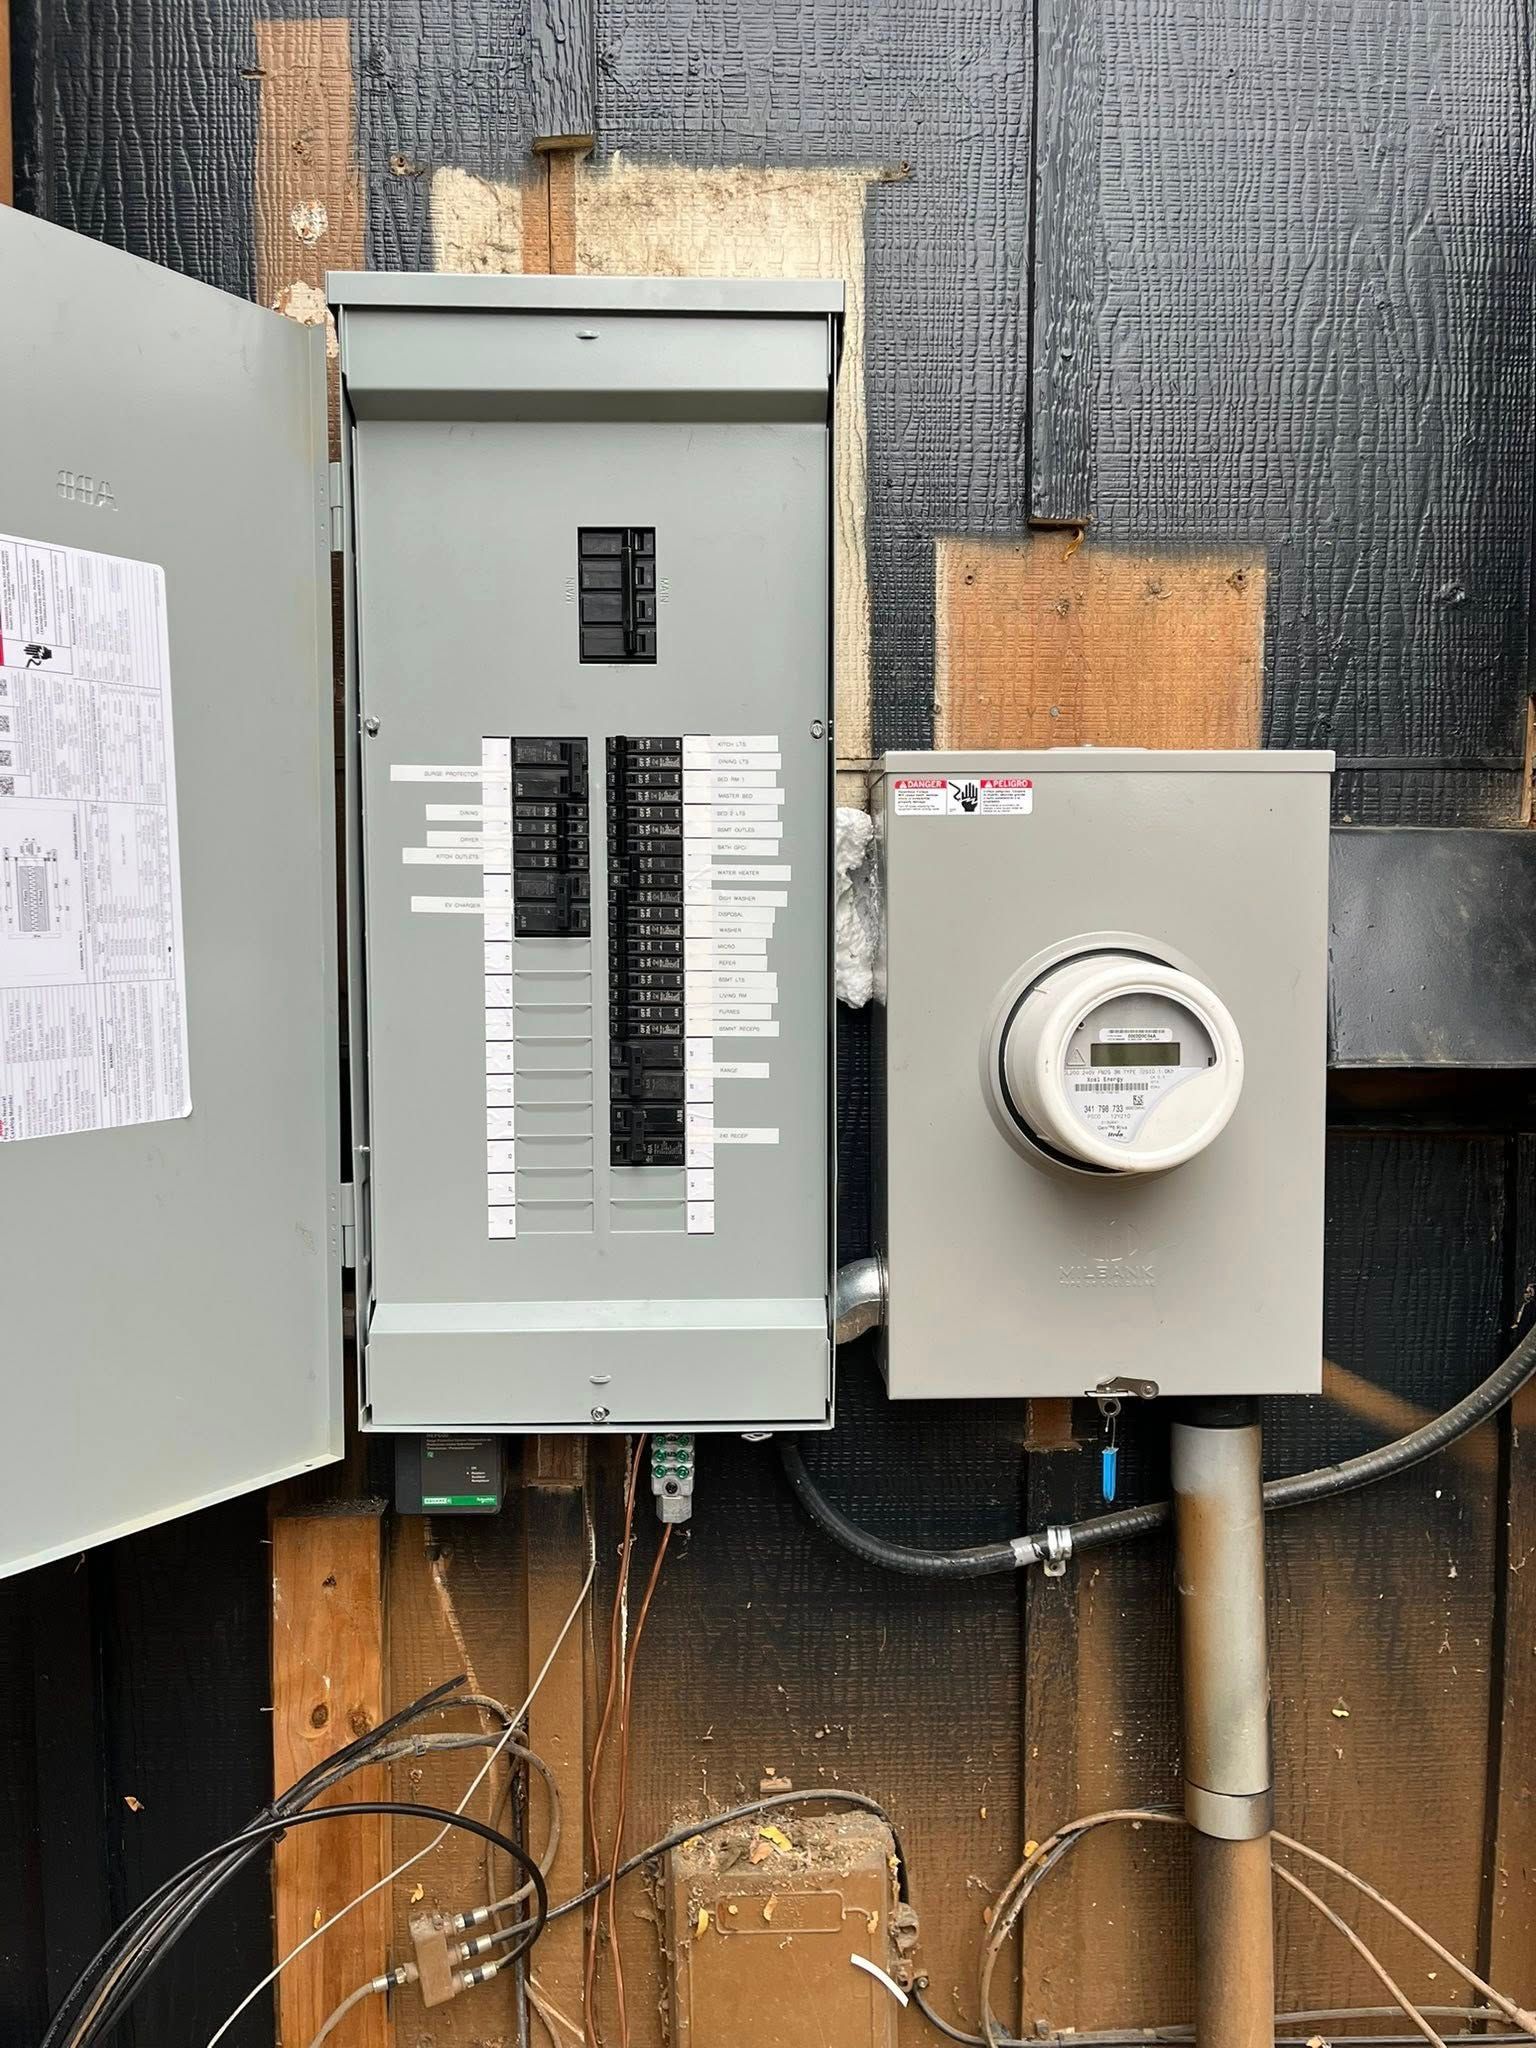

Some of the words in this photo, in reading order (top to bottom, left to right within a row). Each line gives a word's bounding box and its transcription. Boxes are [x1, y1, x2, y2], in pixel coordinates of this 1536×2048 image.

[566, 577, 575, 603] MAIN
[659, 577, 669, 603] MAIN
[1098, 1105, 1109, 1113] 798
